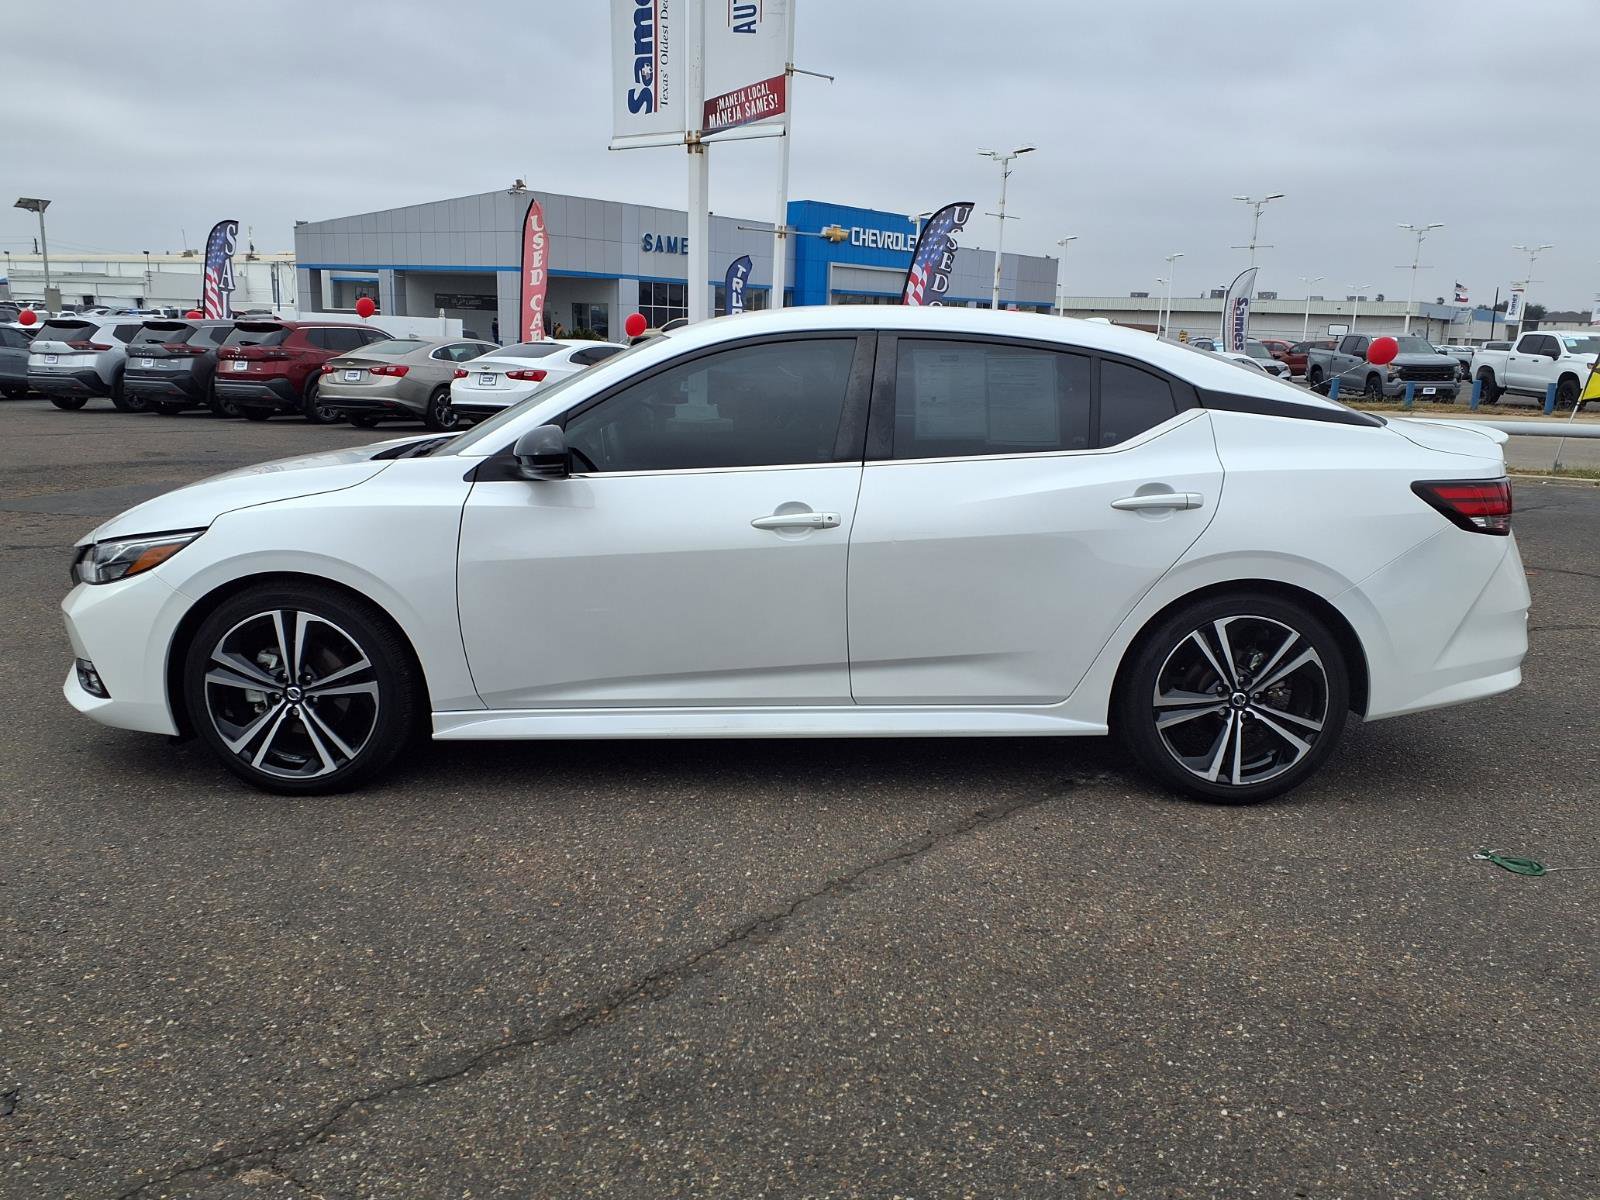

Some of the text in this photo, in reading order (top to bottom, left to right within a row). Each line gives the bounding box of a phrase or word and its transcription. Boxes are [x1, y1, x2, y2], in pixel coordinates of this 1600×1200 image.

[733, 0, 757, 33] AU
[628, 0, 653, 114] Sam
[660, 25, 668, 65] Oldest
[708, 93, 778, 128] MANEJA SAMES!
[748, 82, 770, 99] LOCAL
[530, 215, 544, 286] USED
[931, 205, 969, 293] USED
[1235, 297, 1249, 351] Sames
